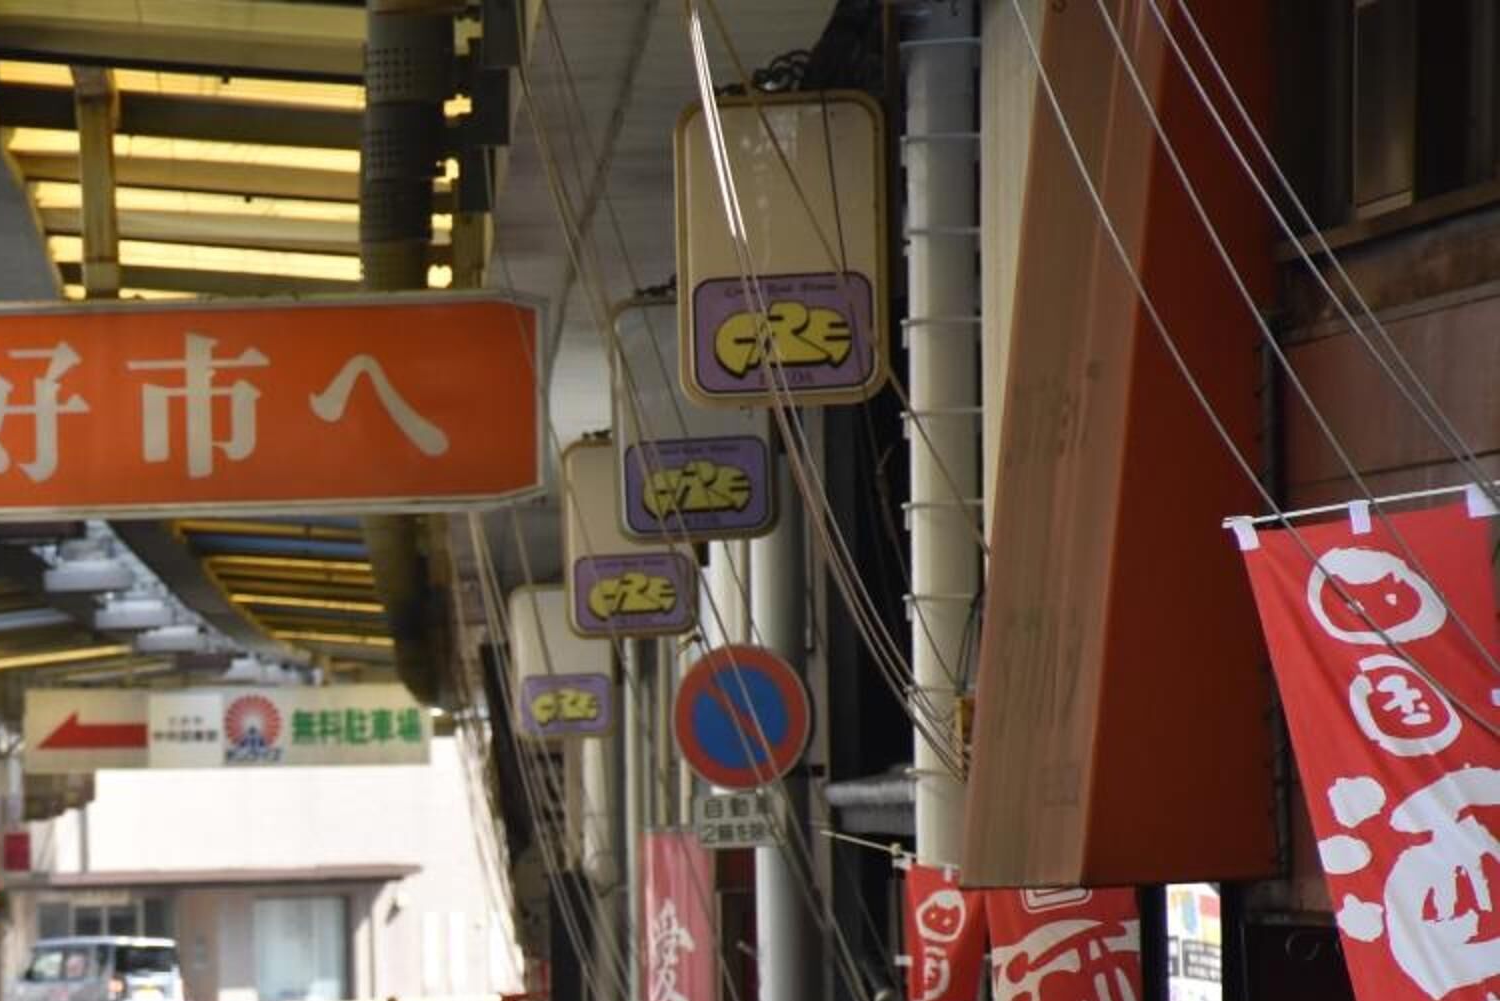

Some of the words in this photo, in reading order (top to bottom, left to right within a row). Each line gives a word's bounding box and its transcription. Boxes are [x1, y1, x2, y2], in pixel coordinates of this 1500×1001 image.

[290, 707, 422, 745] 無料駐車場
